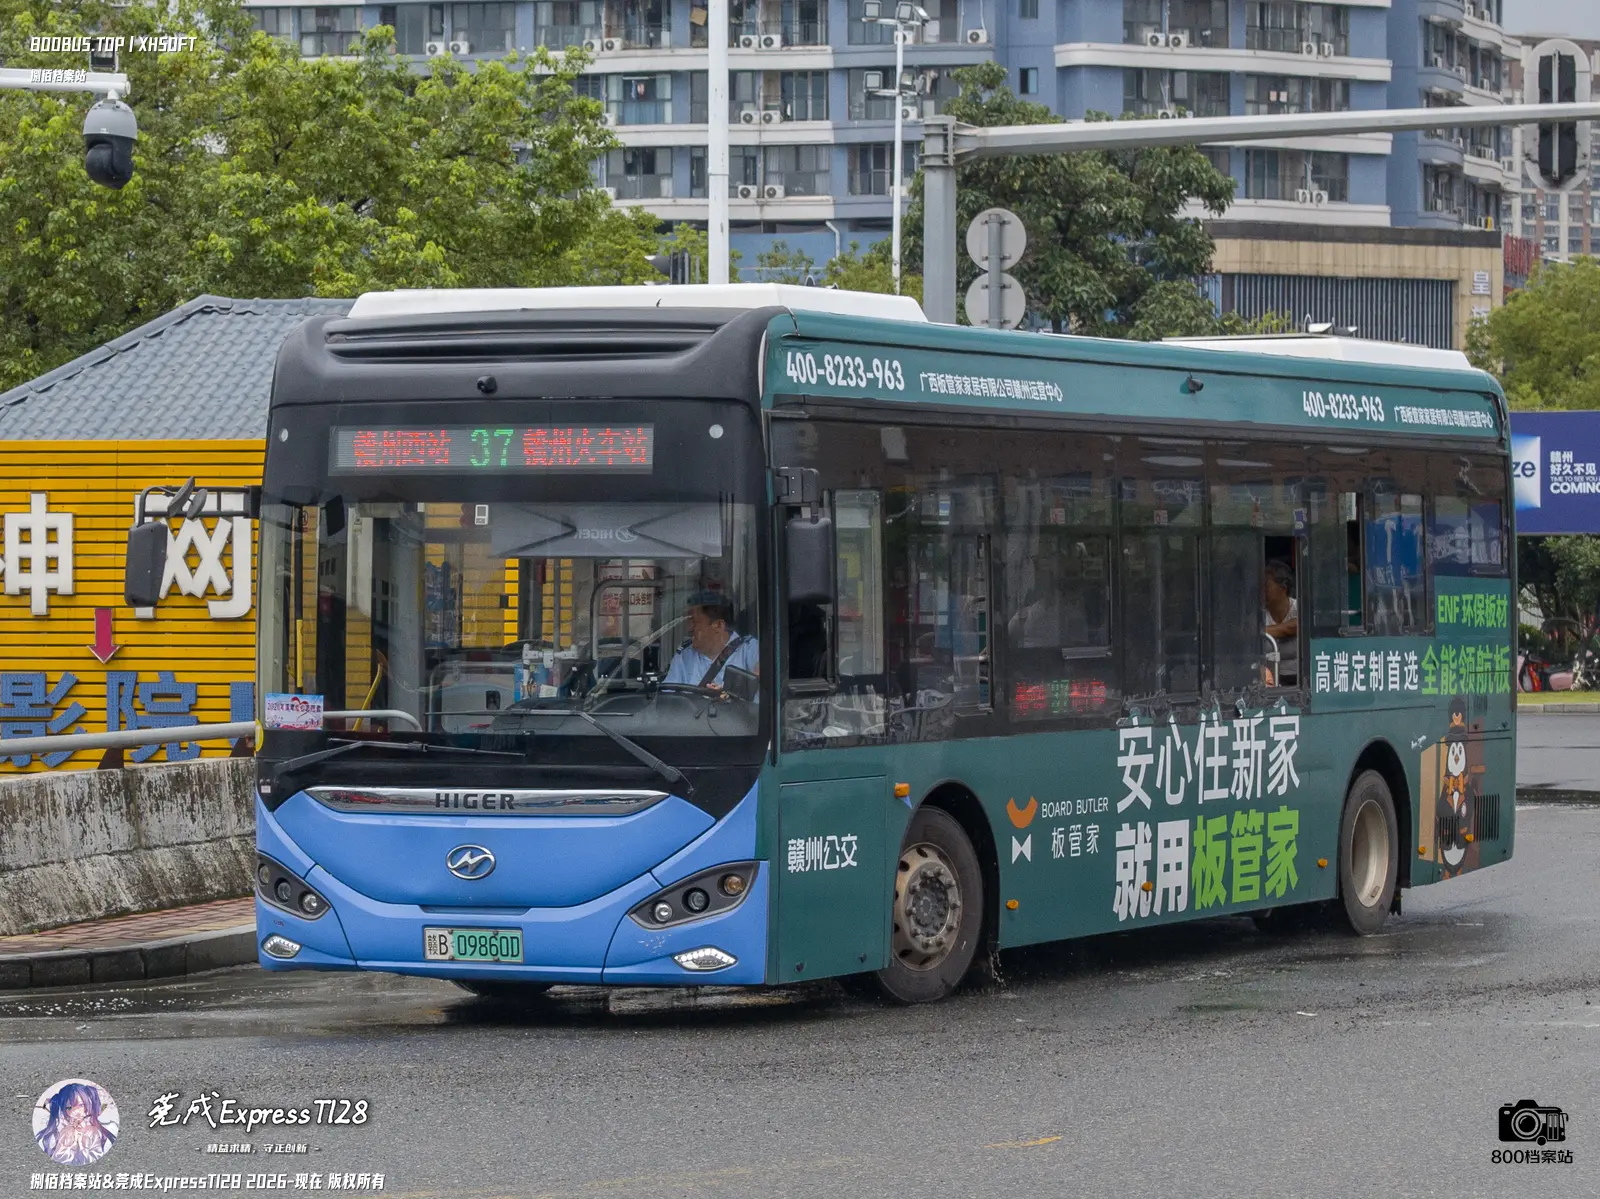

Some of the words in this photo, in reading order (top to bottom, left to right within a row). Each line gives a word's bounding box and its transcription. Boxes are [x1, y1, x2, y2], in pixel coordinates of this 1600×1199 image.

[786, 351, 905, 391] 400-8233-963
[919, 371, 1064, 402] 广西板管家家居有限公司赣州运营中心
[1302, 391, 1385, 422] 400-8233-963
[353, 430, 451, 467] 赣州西站
[470, 429, 514, 466] 37
[522, 428, 648, 466] 赣州火车站
[1550, 463, 1597, 476] 好久不见
[1116, 705, 1300, 814] 安心住新家
[435, 793, 515, 810] HIGER
[1041, 799, 1073, 818] BOARD
[1076, 796, 1109, 815] BUTLER
[788, 833, 858, 873] 赣州公交
[1051, 822, 1100, 859] 板管家
